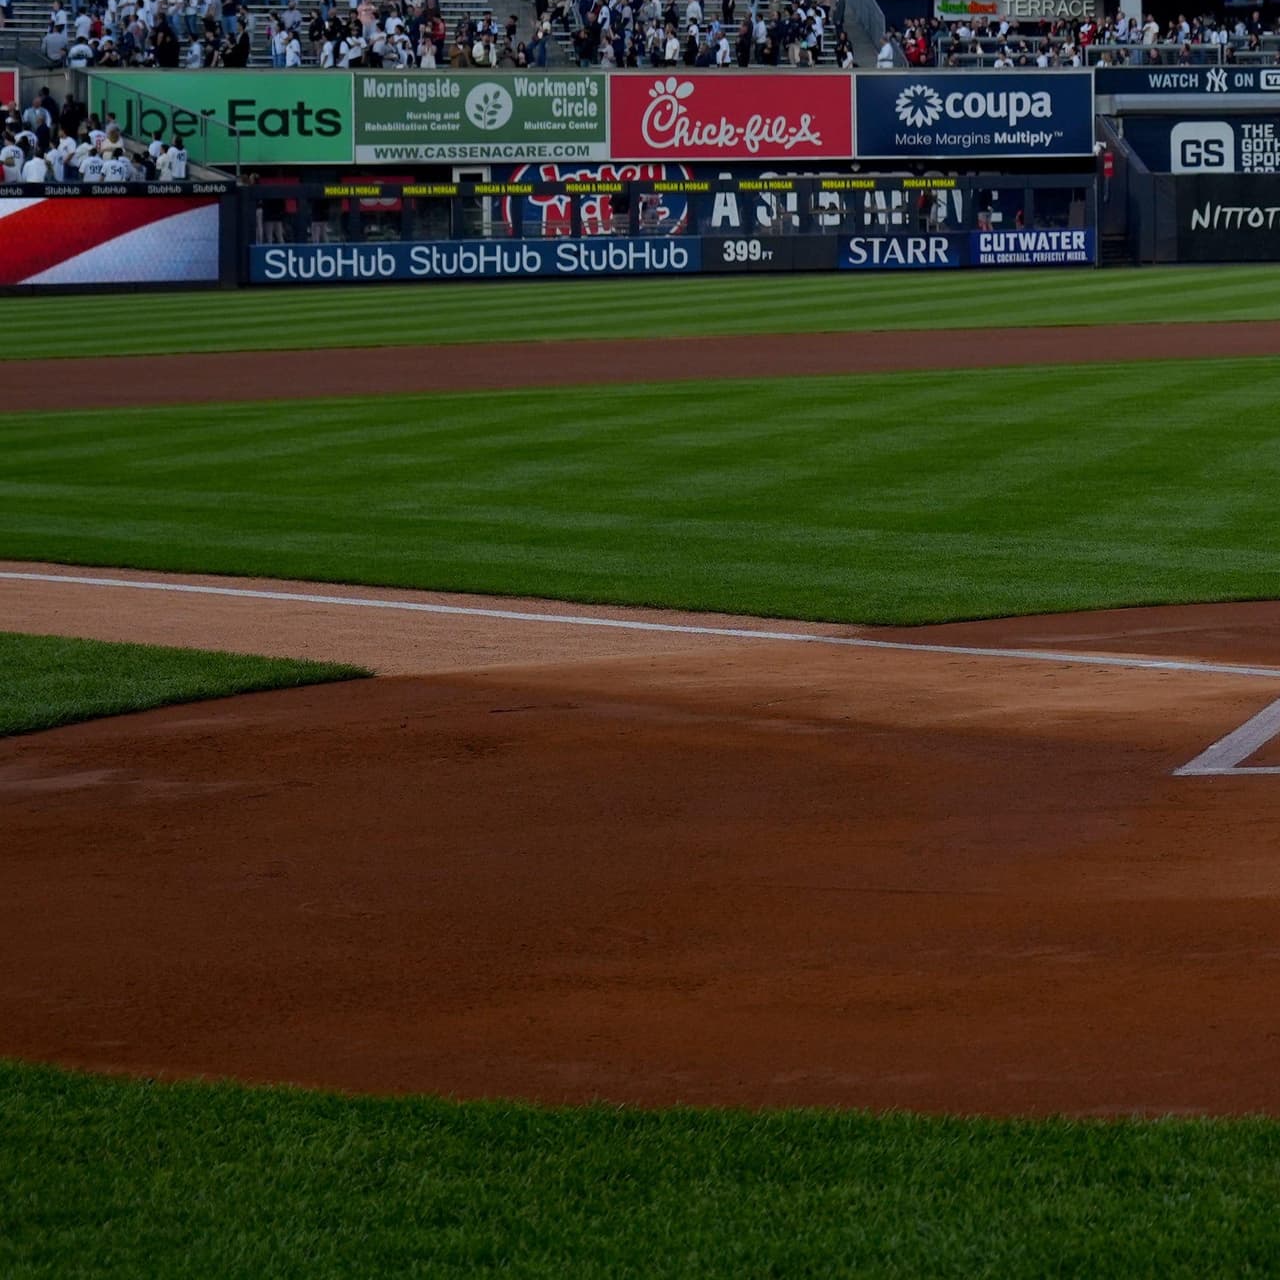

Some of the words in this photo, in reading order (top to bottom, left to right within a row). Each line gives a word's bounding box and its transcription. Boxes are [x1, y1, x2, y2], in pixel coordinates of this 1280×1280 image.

[363, 78, 461, 102] Morningside
[514, 77, 598, 97] Workmen's
[1149, 73, 1199, 88] WATCH
[1234, 73, 1254, 88] ON
[406, 111, 440, 123] Nursing
[443, 111, 461, 120] and
[552, 97, 598, 117] Circle
[945, 90, 1052, 126] coupa
[228, 99, 342, 137] Eats
[365, 122, 428, 131] Rehabilitation
[430, 122, 461, 131] Center
[524, 120, 566, 130] MultiCare
[568, 120, 598, 130] Center
[642, 90, 823, 153] Chick-fil-A
[895, 133, 932, 145] Make
[936, 132, 990, 148] Margins
[1241, 124, 1274, 138] THE
[374, 145, 590, 160] WWW.CASSENACARE.COM
[1180, 138, 1225, 168] GS
[92, 185, 127, 194] StubHub
[147, 184, 182, 193] StubHub
[193, 183, 226, 193] StubHub
[723, 239, 761, 262] 399
[762, 252, 774, 260] FT
[849, 237, 949, 264] STARR
[980, 231, 1085, 252] CUTWATER
[265, 248, 396, 279] StubHub
[410, 244, 541, 275] StubHub
[556, 241, 688, 271] StubHub
[980, 254, 995, 263] REAL
[996, 253, 1031, 263] COCKTAILS.
[1033, 252, 1065, 262] PERFECTLY
